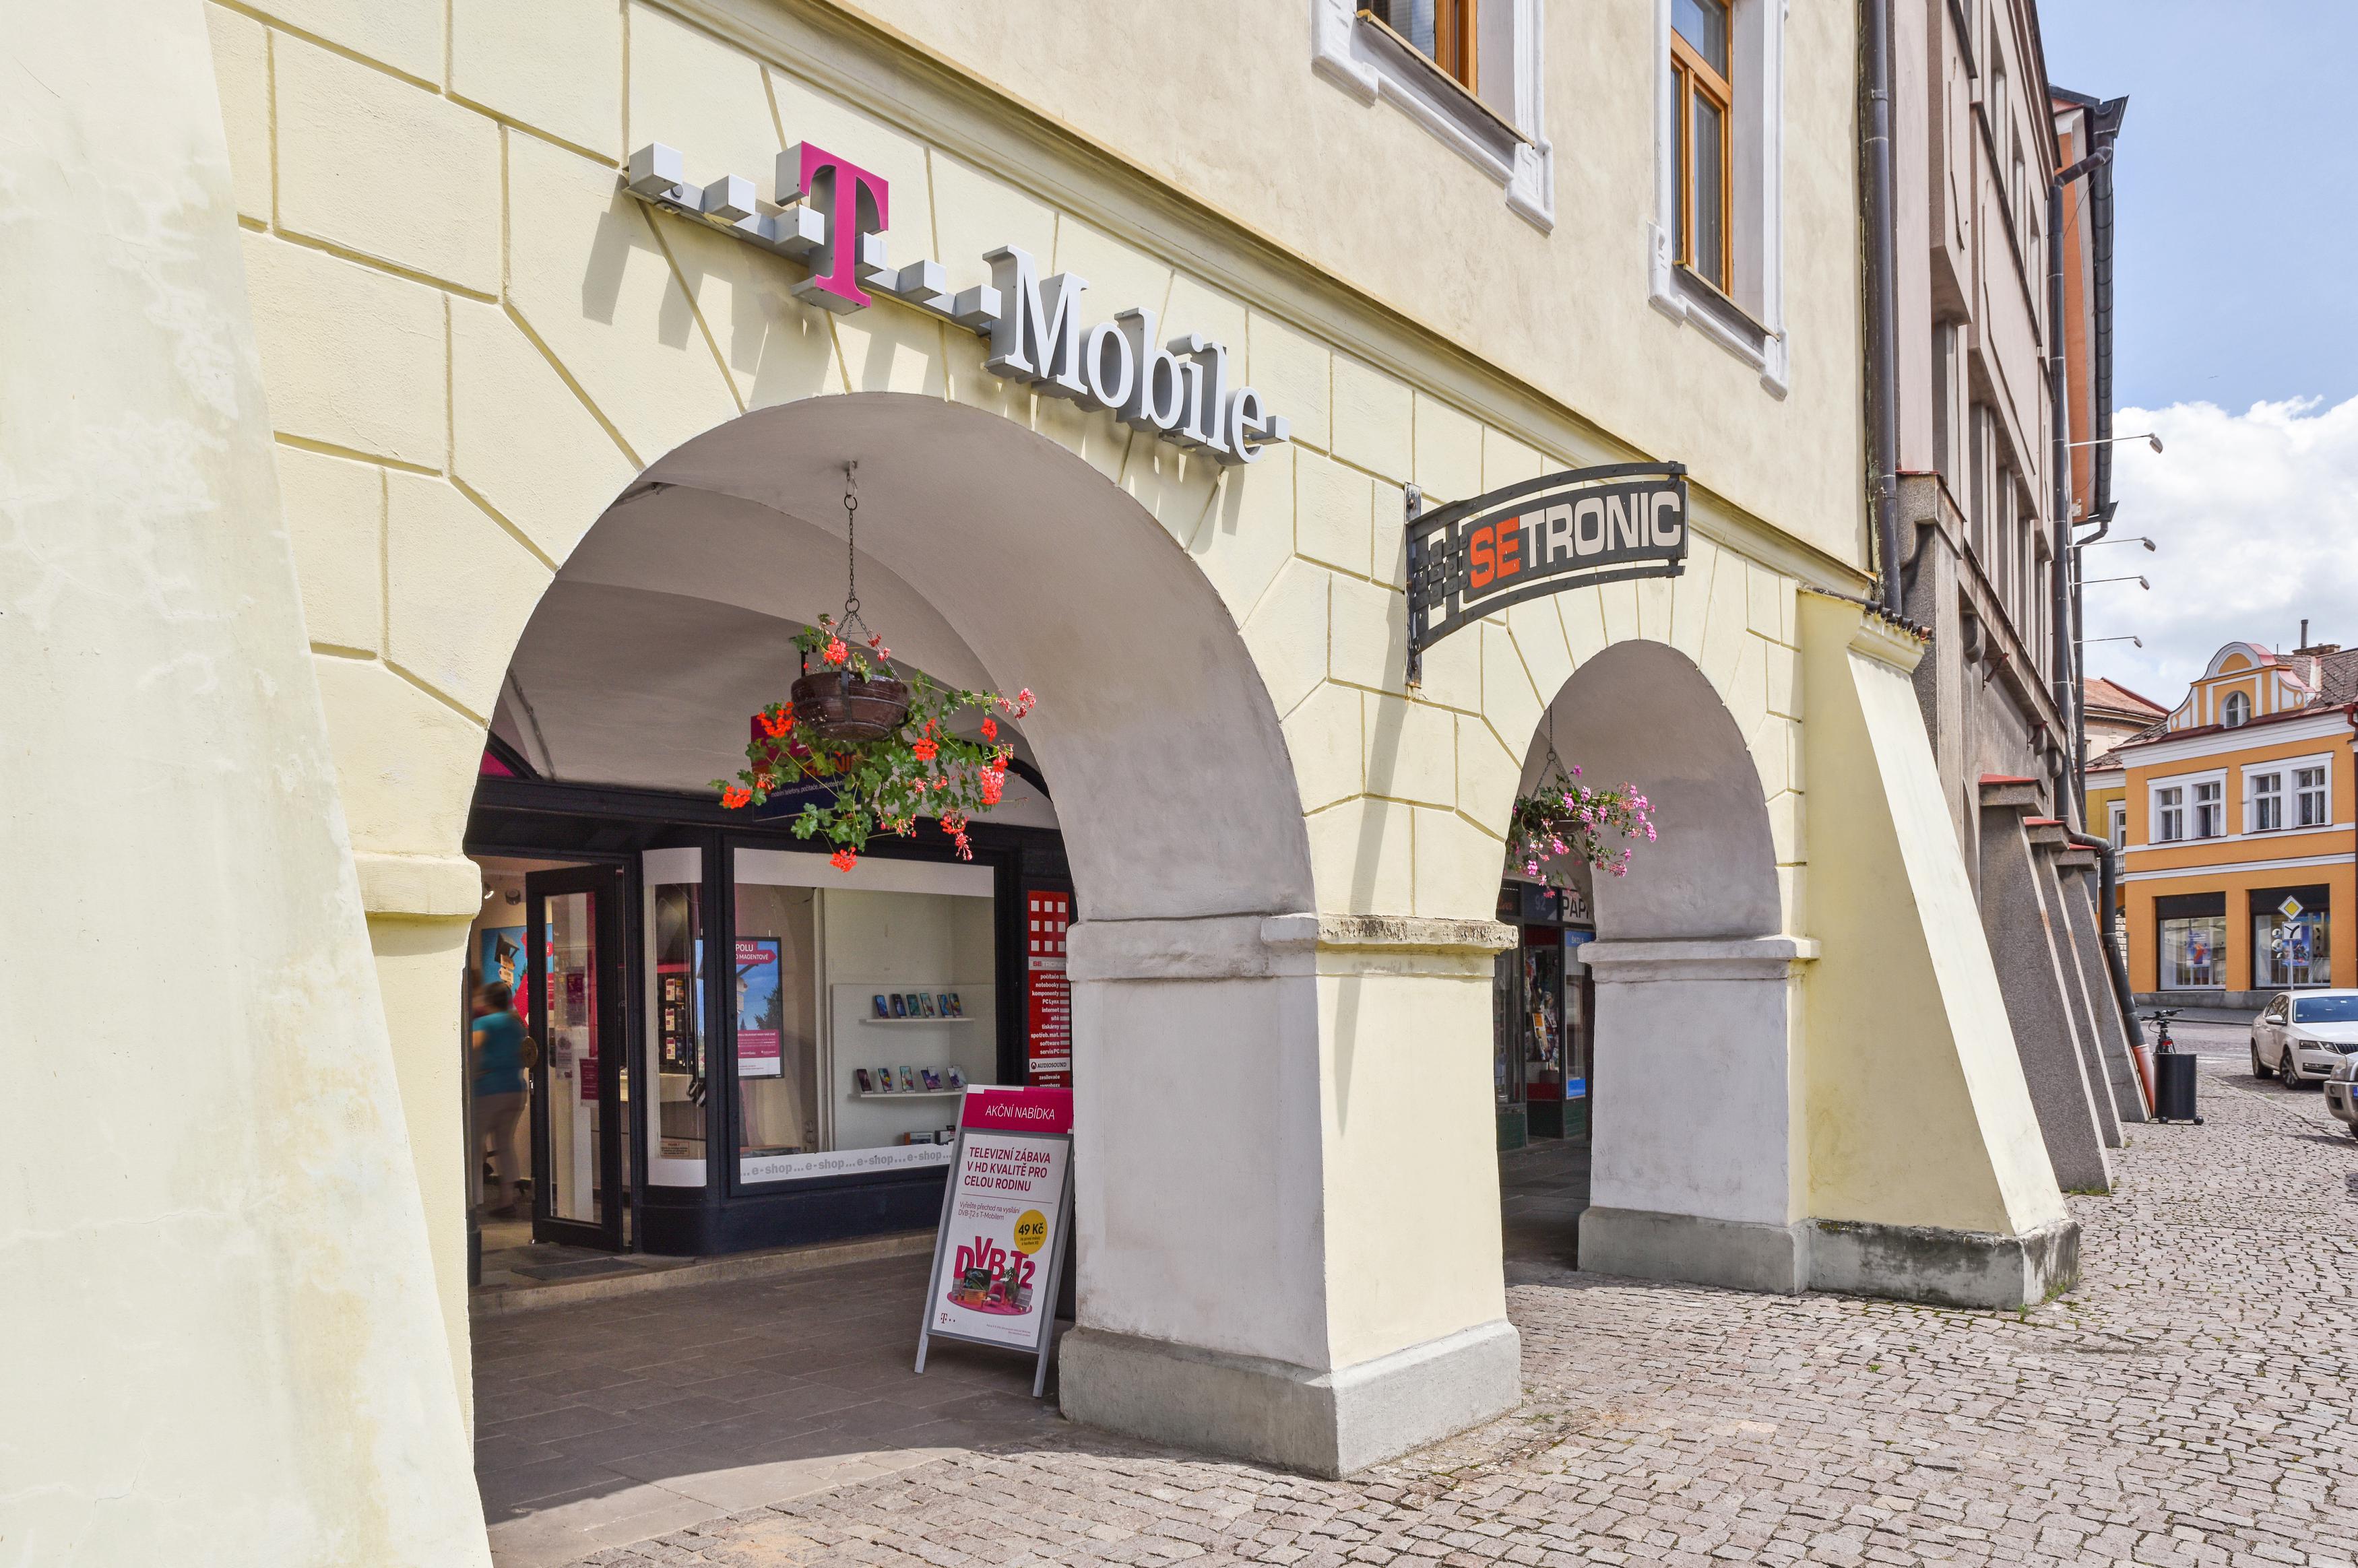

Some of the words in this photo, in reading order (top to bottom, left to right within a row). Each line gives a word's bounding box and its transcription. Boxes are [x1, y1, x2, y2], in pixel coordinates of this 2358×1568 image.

[985, 244, 1267, 465] Mobile
[1470, 491, 1681, 589] SETRONIC
[735, 944, 753, 952] POLU
[985, 1103, 1015, 1117] AKČNÍ
[1015, 1105, 1055, 1120] NABÍDKA
[969, 1146, 1015, 1161] TELEVIZNÍ
[1014, 1148, 1051, 1164] ZÁBAVA
[967, 1161, 974, 1171] V
[974, 1162, 988, 1173] HD
[990, 1163, 1027, 1177] KVALITĚ
[1028, 1166, 1048, 1179] PRO
[964, 1175, 994, 1188] CELOU
[995, 1178, 1031, 1191] RODINU
[958, 1209, 976, 1218] DVB-T2
[980, 1212, 1005, 1220] T-Mobilem
[959, 1201, 977, 1209] Vyřešte
[977, 1204, 996, 1212] přechod
[1018, 1224, 1030, 1235] 49
[1032, 1222, 1044, 1235] Kč
